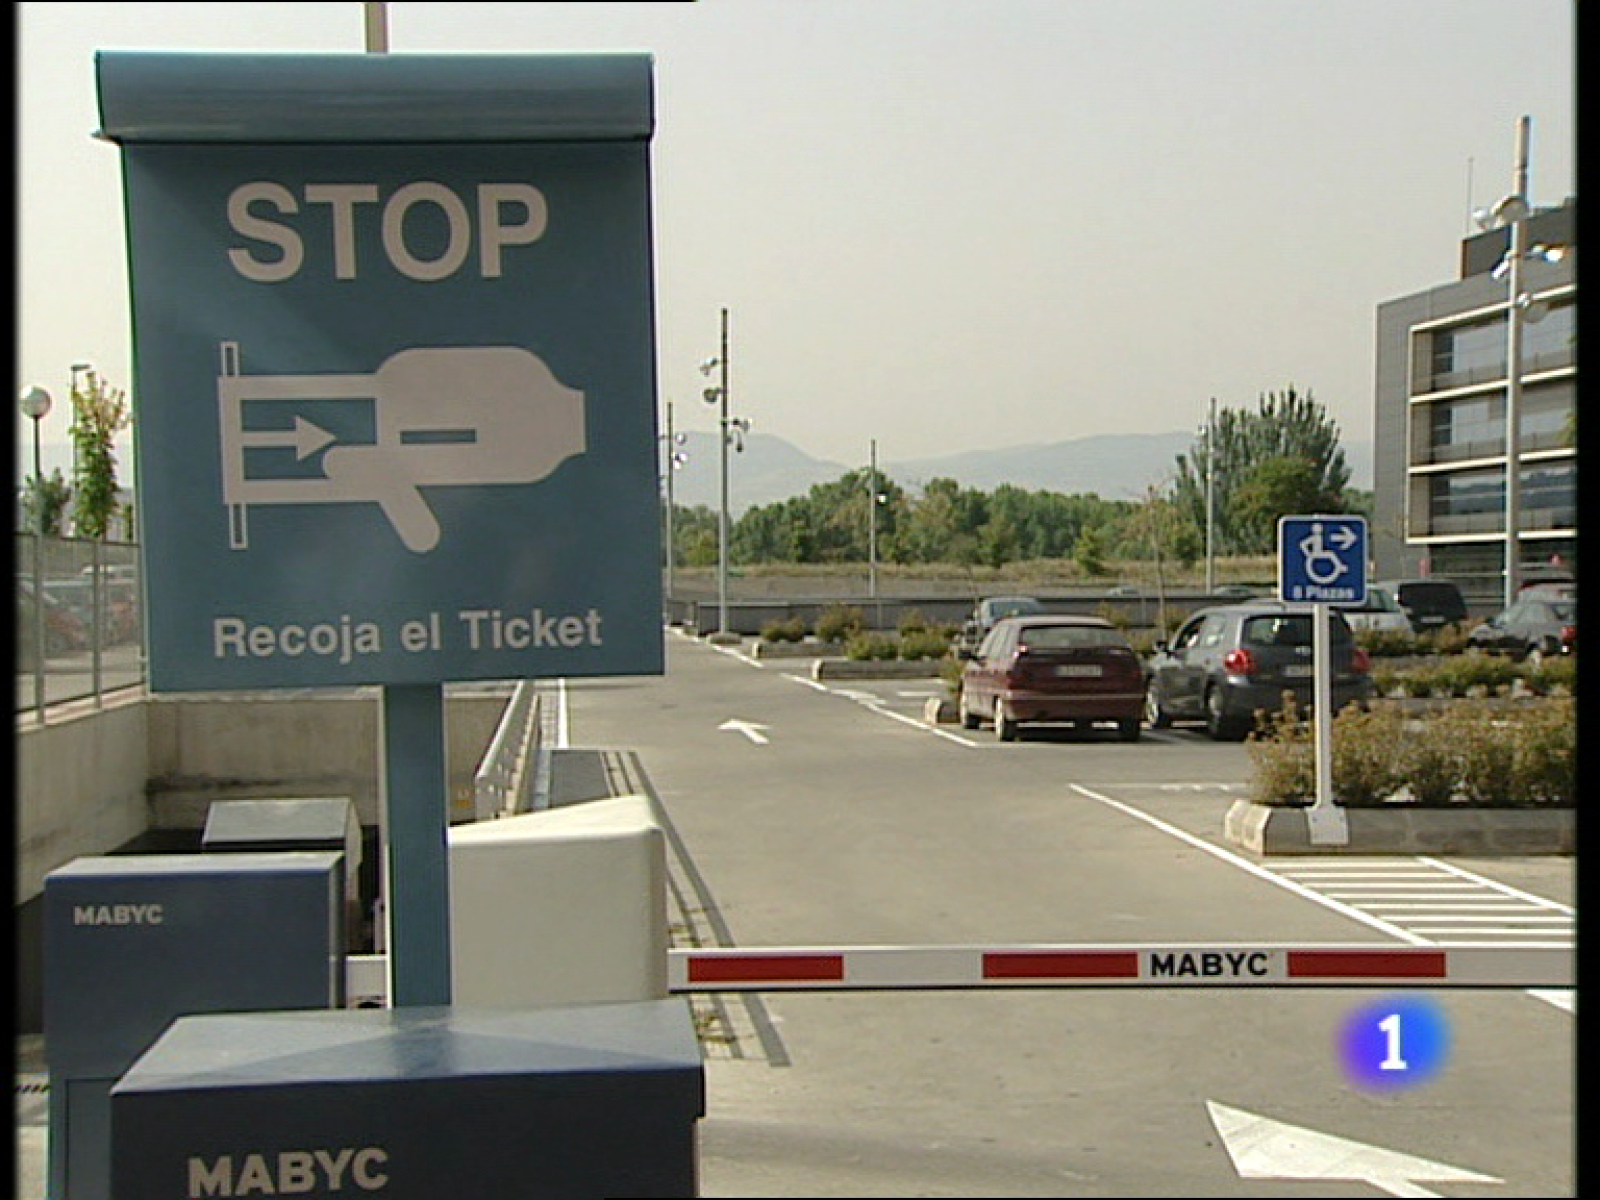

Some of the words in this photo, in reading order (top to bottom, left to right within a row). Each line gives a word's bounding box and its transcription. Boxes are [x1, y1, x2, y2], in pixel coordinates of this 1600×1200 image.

[227, 182, 548, 281] STOP
[213, 616, 382, 665] Recoja
[401, 613, 443, 652] el
[459, 608, 604, 650] Ticket
[74, 904, 164, 926] MABYC
[1150, 952, 1269, 978] MABYC
[188, 1148, 389, 1198] MABYC
